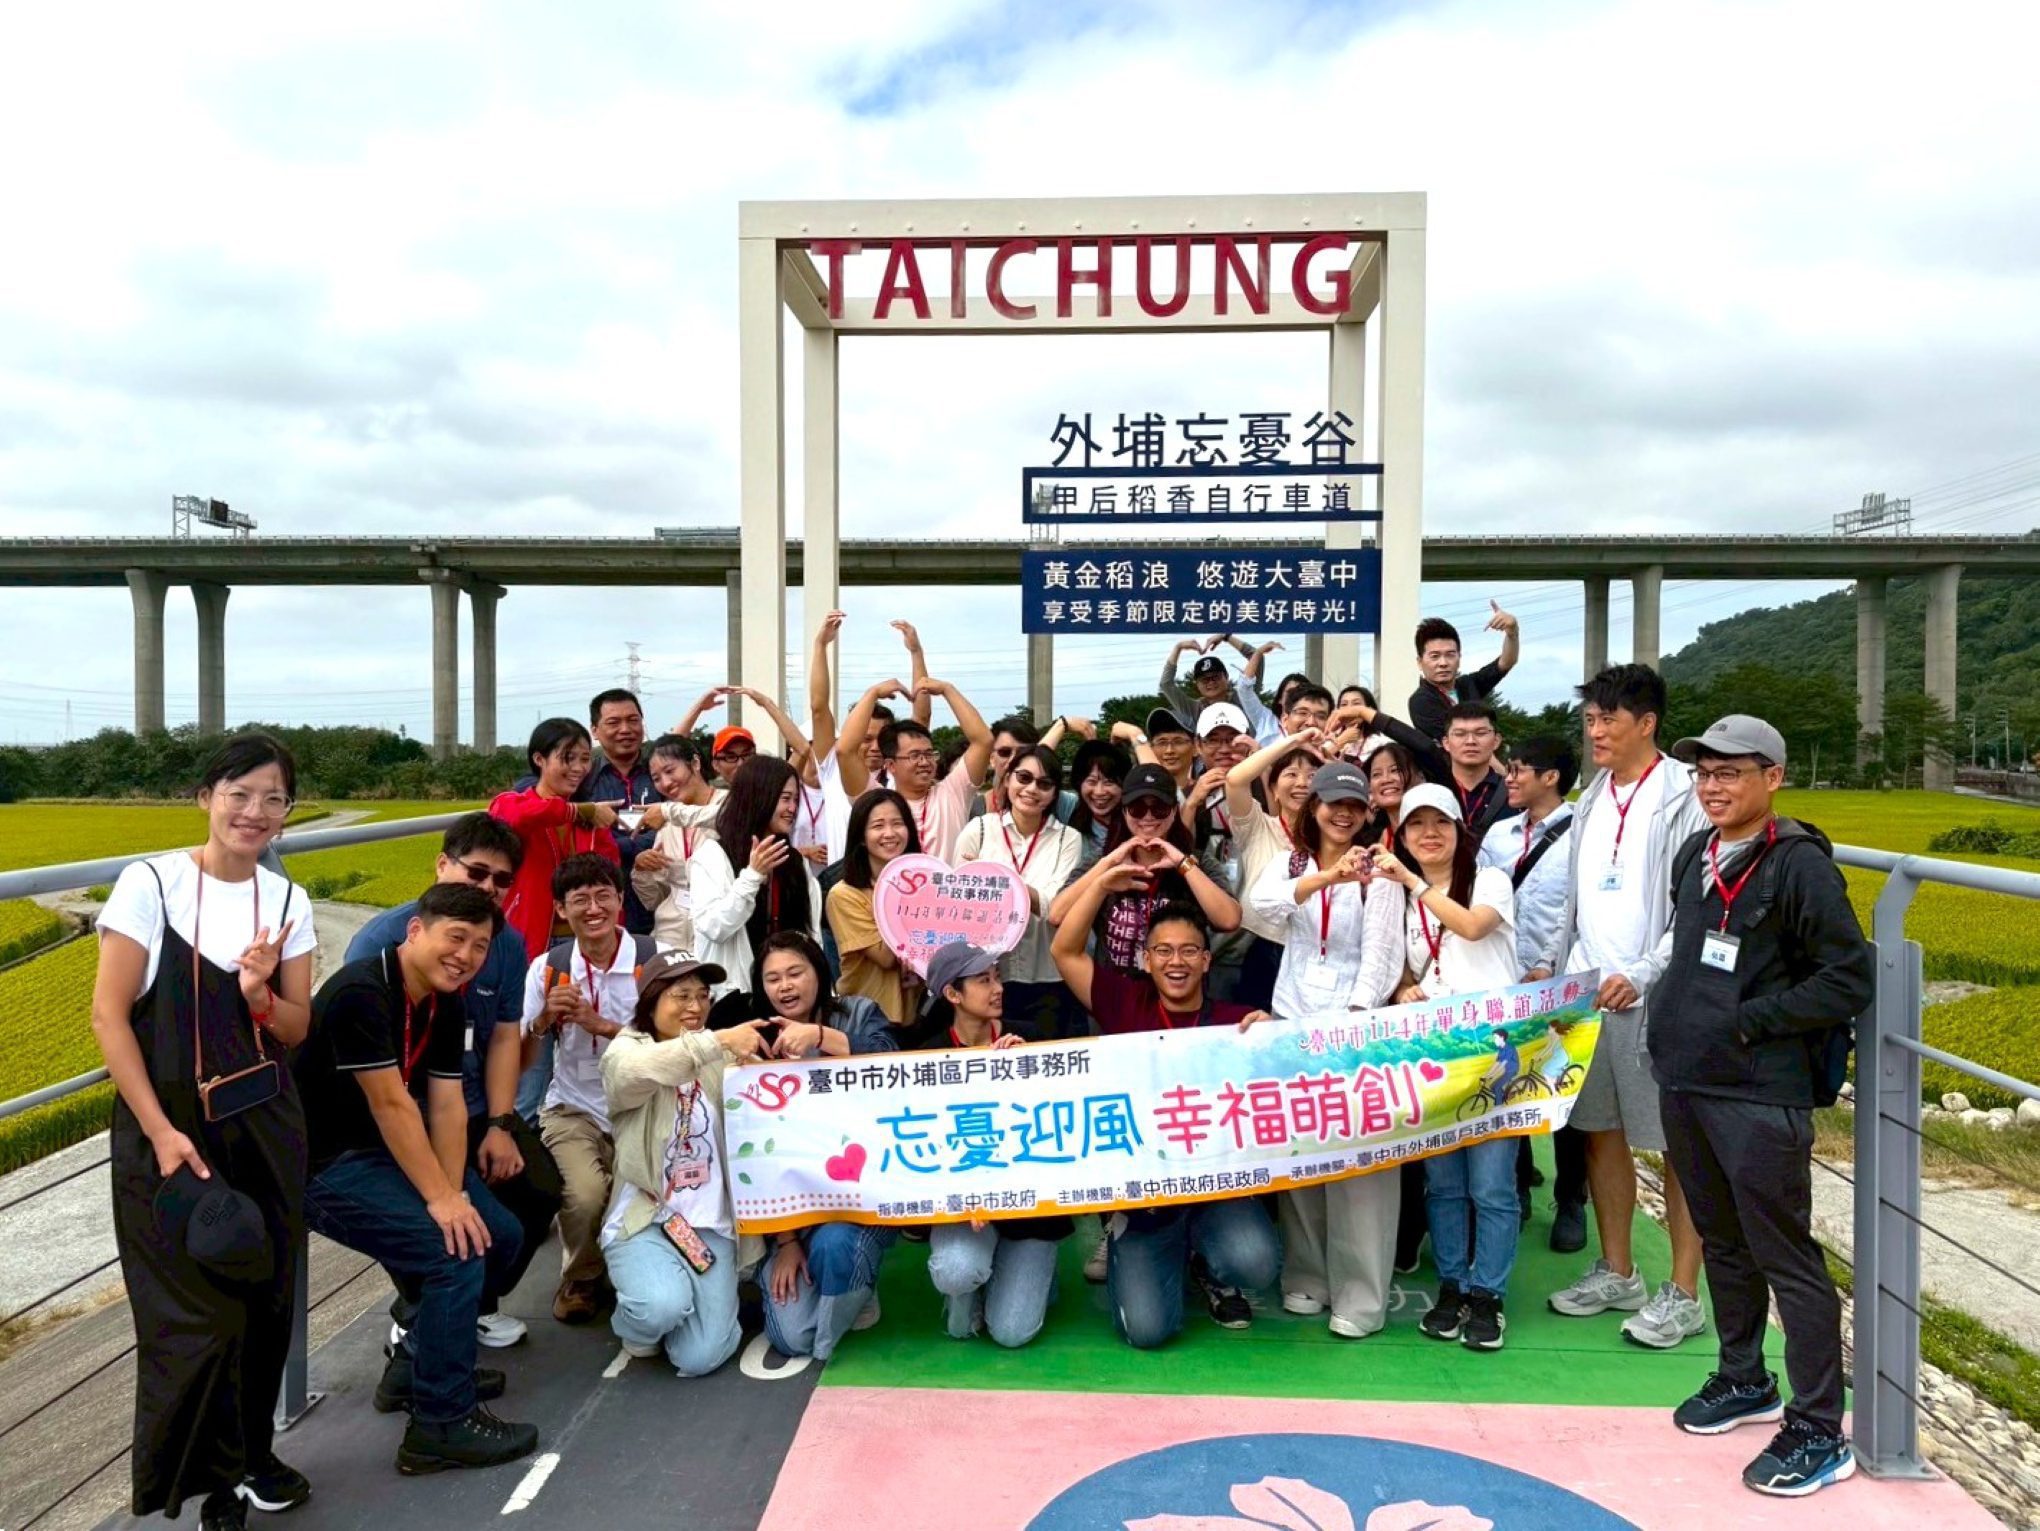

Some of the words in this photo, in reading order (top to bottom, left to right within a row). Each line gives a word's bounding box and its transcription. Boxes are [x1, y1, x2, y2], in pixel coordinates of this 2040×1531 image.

[810, 234, 1351, 320] TAICHUNG
[1050, 411, 1357, 467] 外埔忘憂谷
[1053, 483, 1351, 514] 甲后稻香自行車道
[1042, 560, 1170, 590] 黃金稻浪
[1196, 560, 1358, 590] 悠遊大臺中
[808, 1049, 1091, 1095] 臺中市外埔區戶政事務所
[876, 1092, 1144, 1174] 忘憂迎風
[1152, 1062, 1422, 1155] 幸福萌創
